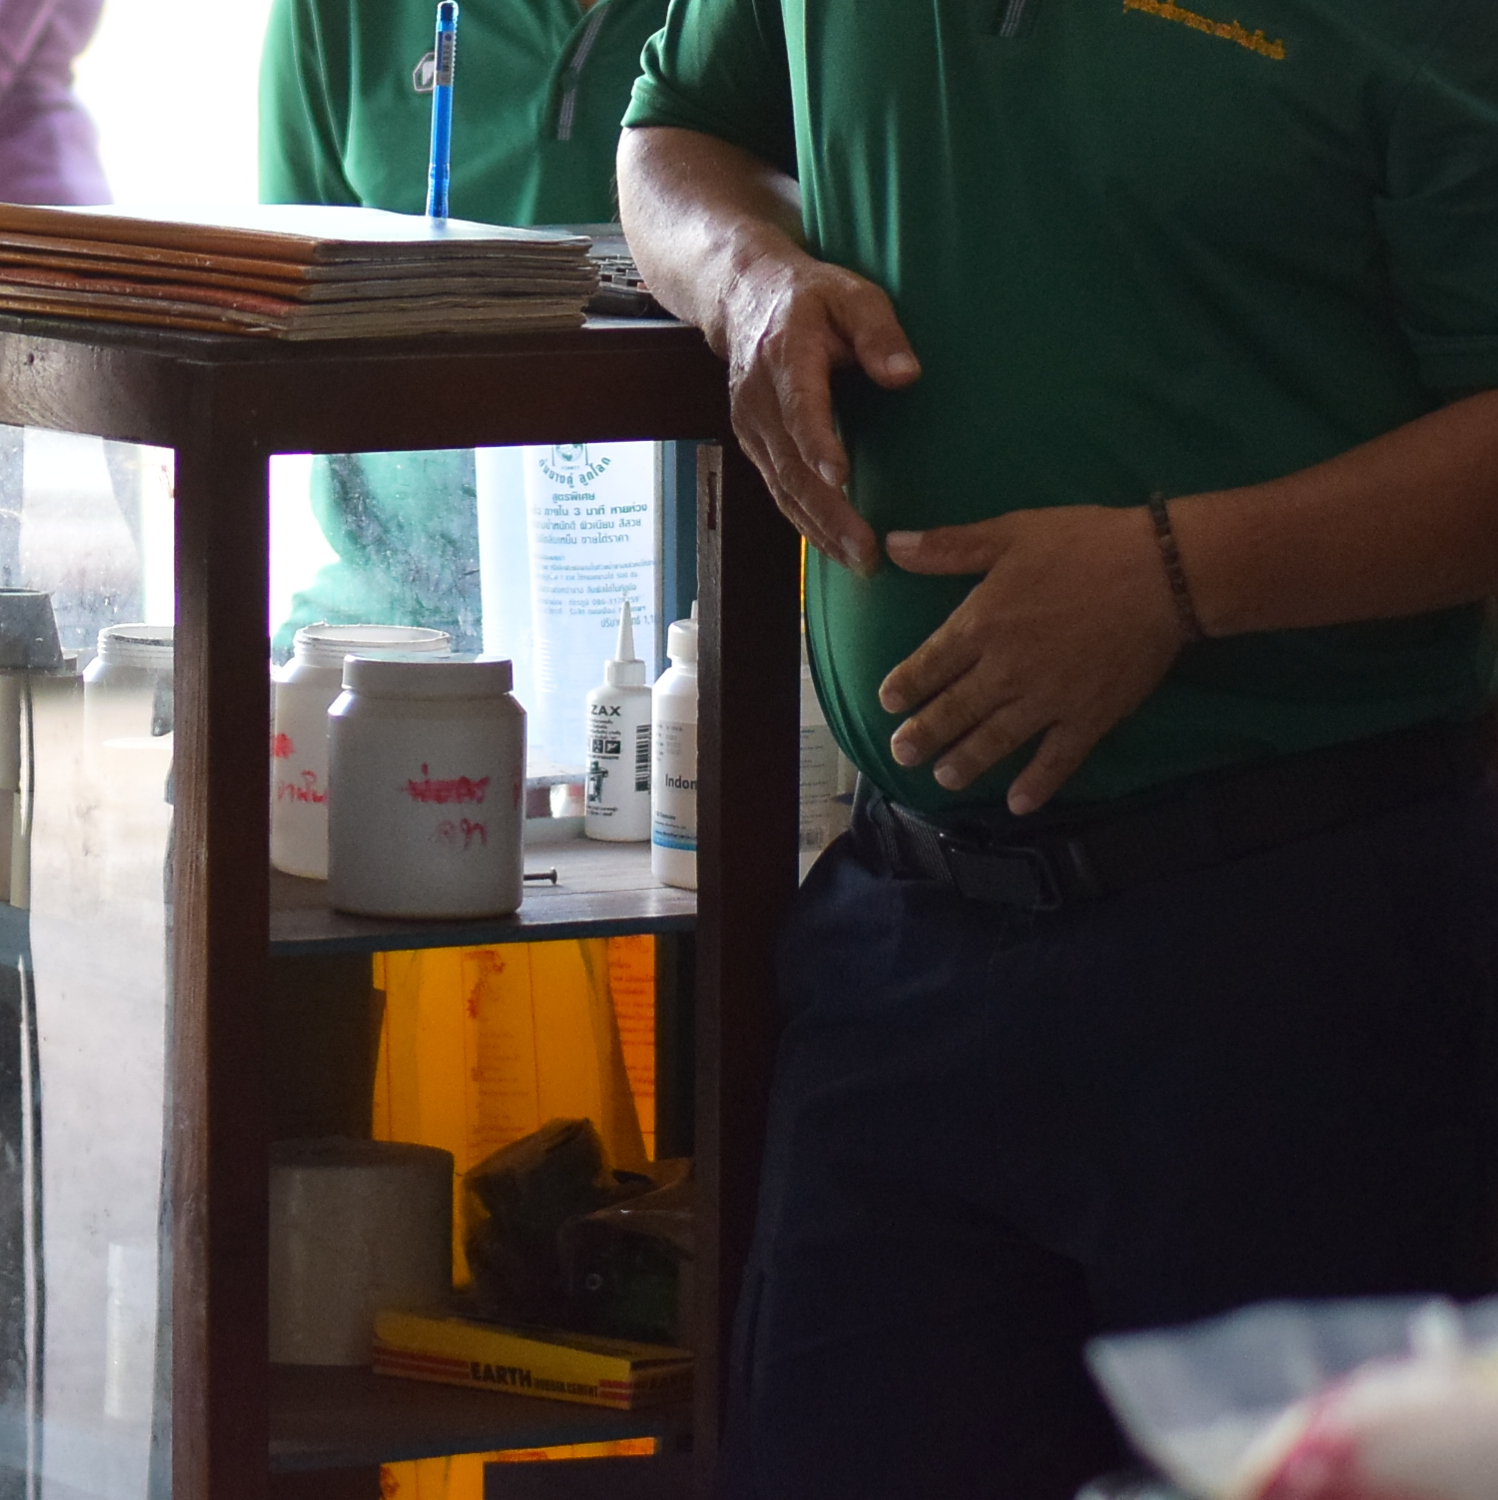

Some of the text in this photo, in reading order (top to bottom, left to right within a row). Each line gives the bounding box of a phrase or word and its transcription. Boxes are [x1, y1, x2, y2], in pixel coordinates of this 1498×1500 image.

[578, 455, 612, 486] ลูกโลก
[552, 491, 596, 504] สูตรพิเศษ
[574, 506, 582, 516] 3
[586, 504, 606, 516] นาที
[590, 704, 622, 717] ZAX
[470, 1361, 532, 1388] EARTH
